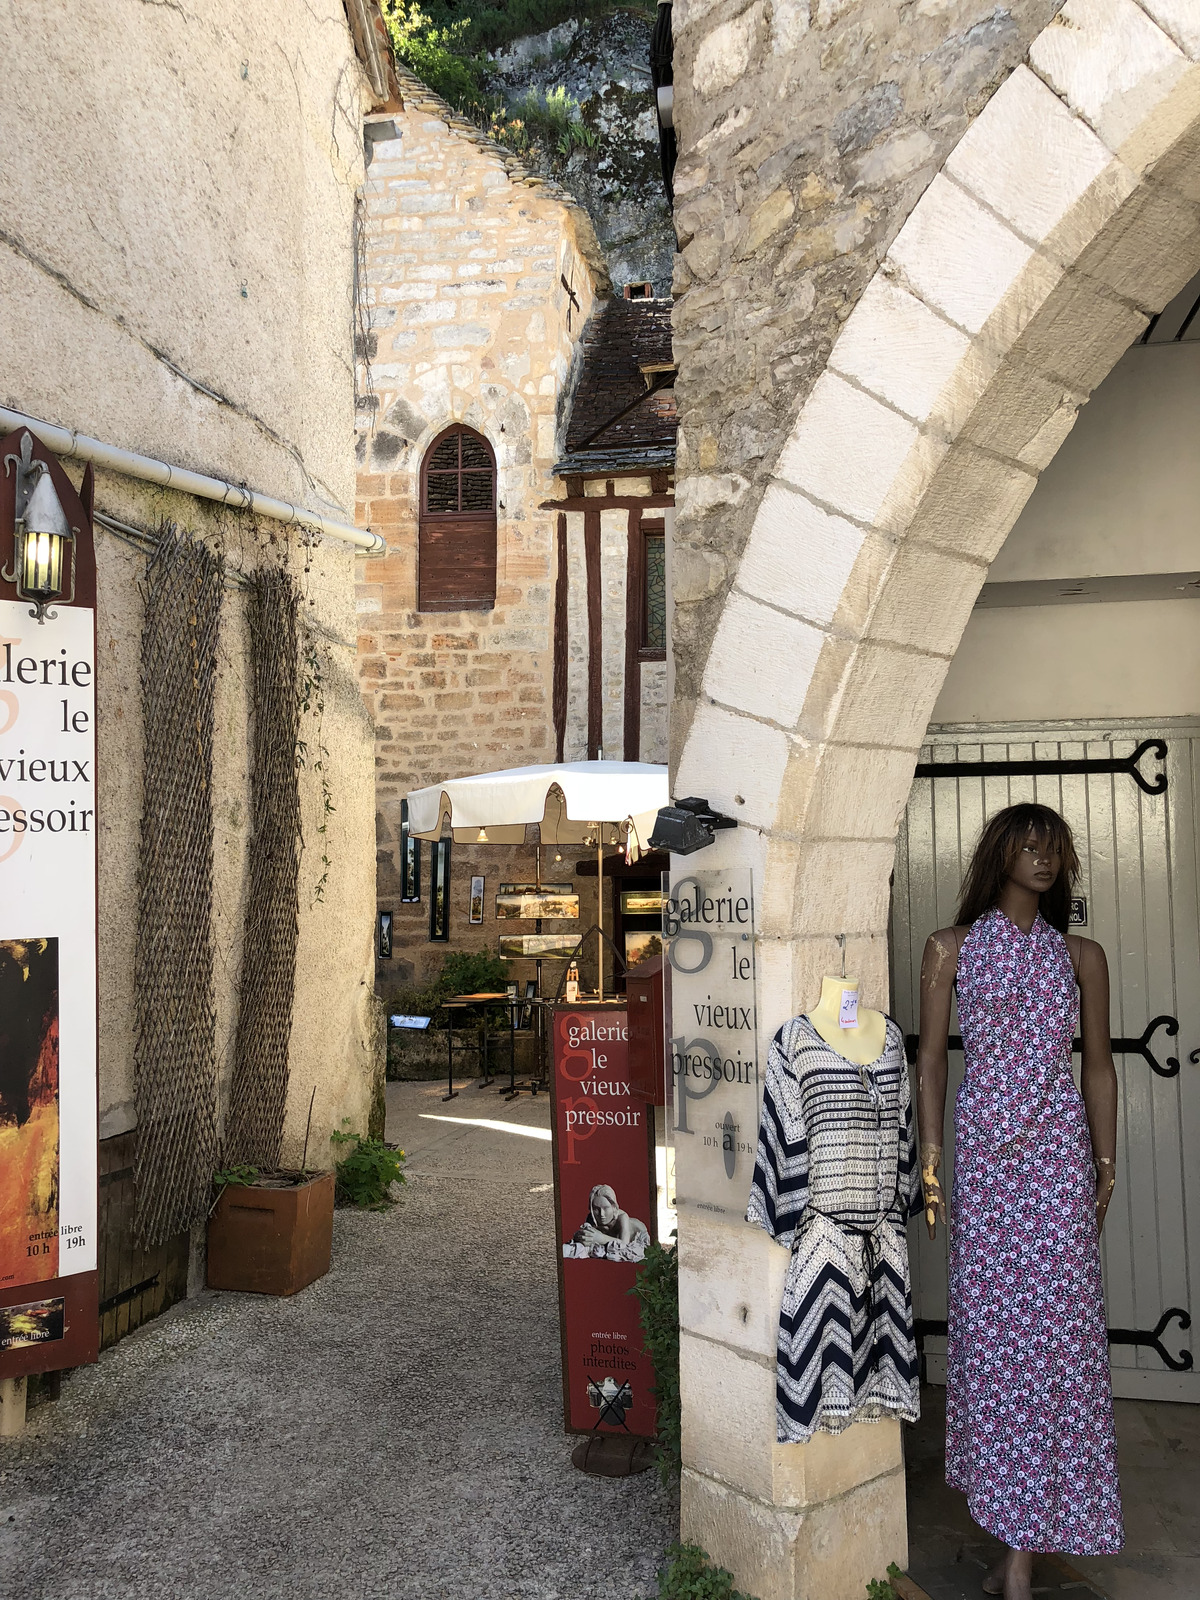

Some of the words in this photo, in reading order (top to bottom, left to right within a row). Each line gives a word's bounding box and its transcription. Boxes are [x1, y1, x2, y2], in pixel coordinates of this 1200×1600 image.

[0, 643, 91, 687] lerie
[61, 699, 89, 733] le
[0, 749, 90, 782] vieux
[0, 800, 93, 832] essoir
[665, 885, 749, 937] galerie
[731, 946, 750, 980] le
[693, 995, 752, 1030] vieux
[568, 1020, 629, 1048] galerie
[591, 1047, 608, 1069] le
[670, 1050, 753, 1087] pressoir
[580, 1075, 631, 1096] vieux
[565, 1106, 641, 1132] pressoir
[714, 1122, 741, 1133] ouvert
[703, 1136, 712, 1147] 10
[713, 1137, 719, 1148] h
[736, 1142, 746, 1152] 19
[747, 1143, 753, 1154] h
[28, 1228, 59, 1242] entrée
[60, 1225, 83, 1236] libre
[26, 1245, 40, 1257] 10
[42, 1243, 50, 1255] h
[65, 1236, 86, 1249] 19h
[1, 1333, 29, 1346] entrée
[30, 1330, 50, 1341] libre
[591, 1331, 611, 1340] entrée
[612, 1332, 628, 1340] libre
[590, 1340, 630, 1356] photos
[582, 1354, 637, 1371] interdites
